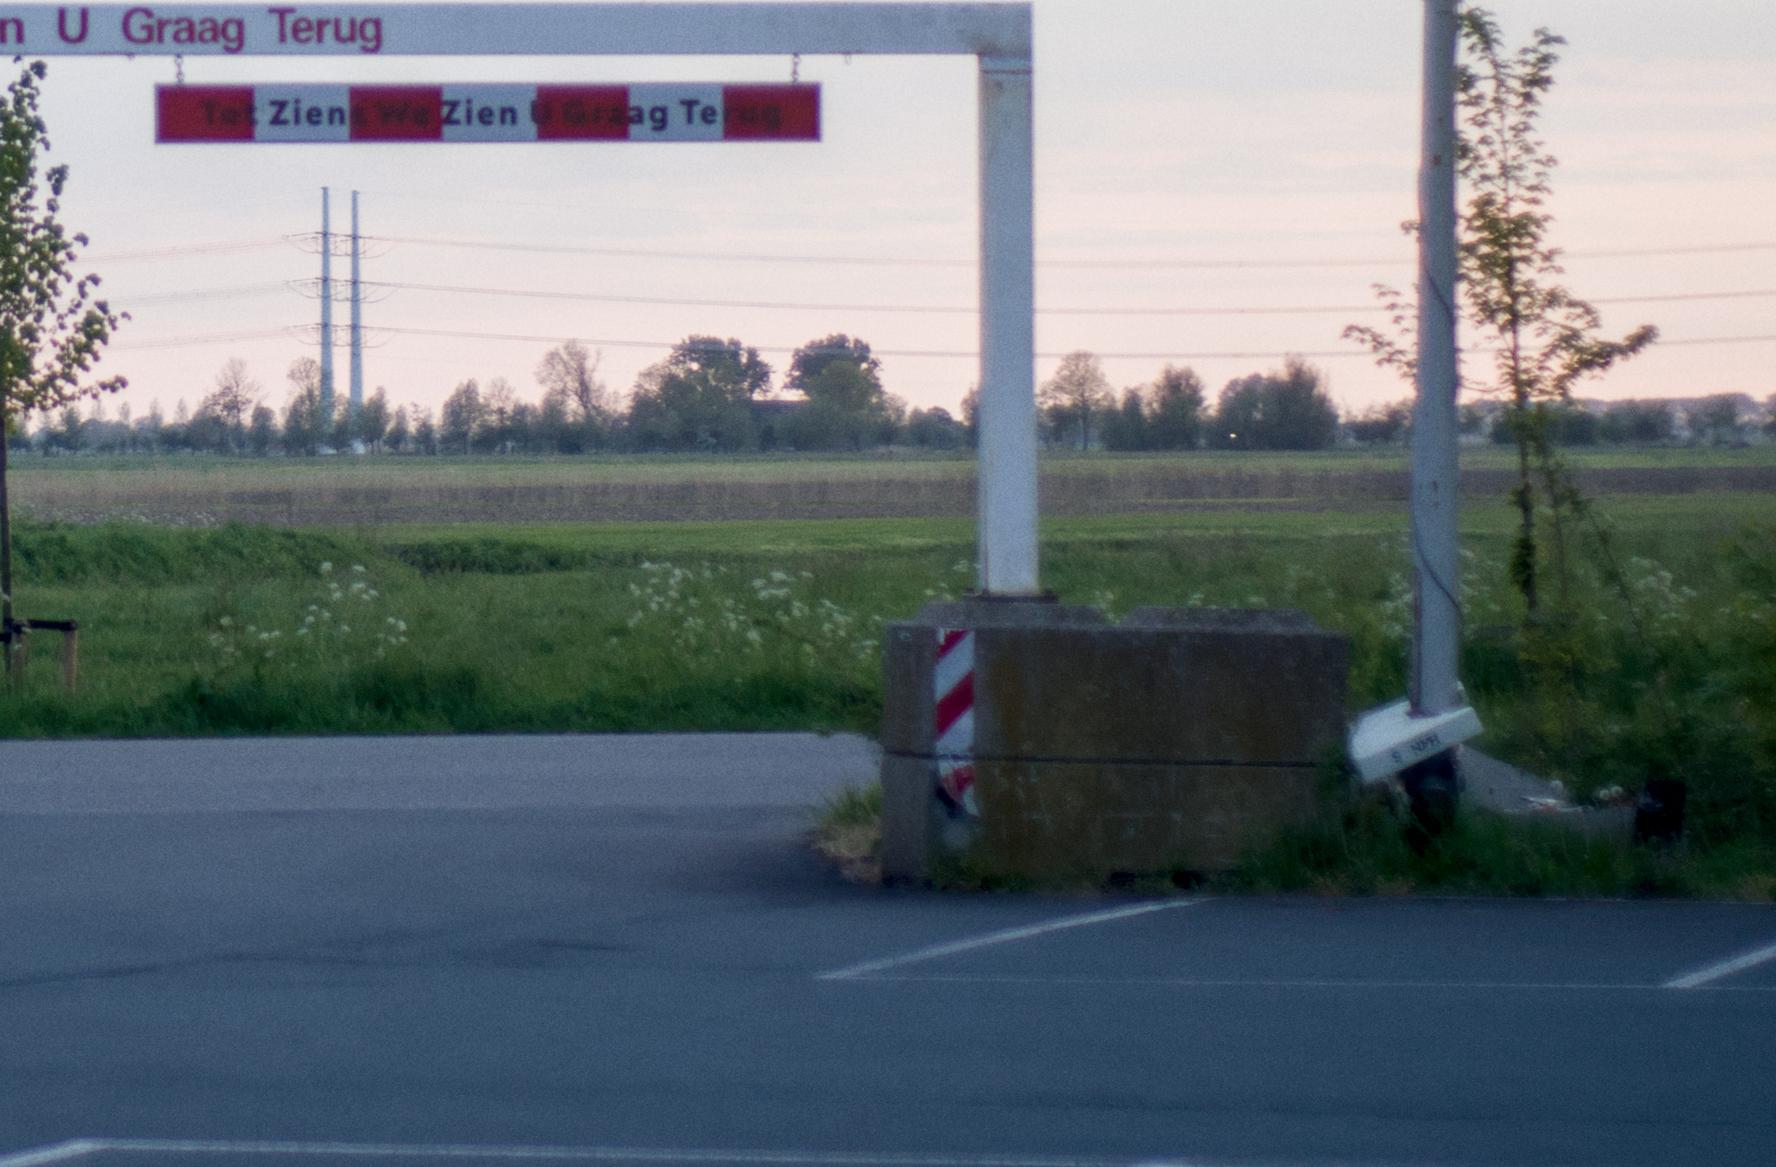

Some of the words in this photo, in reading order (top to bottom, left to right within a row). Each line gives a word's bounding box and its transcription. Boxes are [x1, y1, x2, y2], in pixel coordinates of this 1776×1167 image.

[57, 6, 90, 45] U
[121, 6, 246, 54] Graag
[268, 6, 384, 54] Terug
[268, 98, 368, 127] Ziens
[441, 99, 518, 126] Zien
[562, 99, 670, 132] Graag
